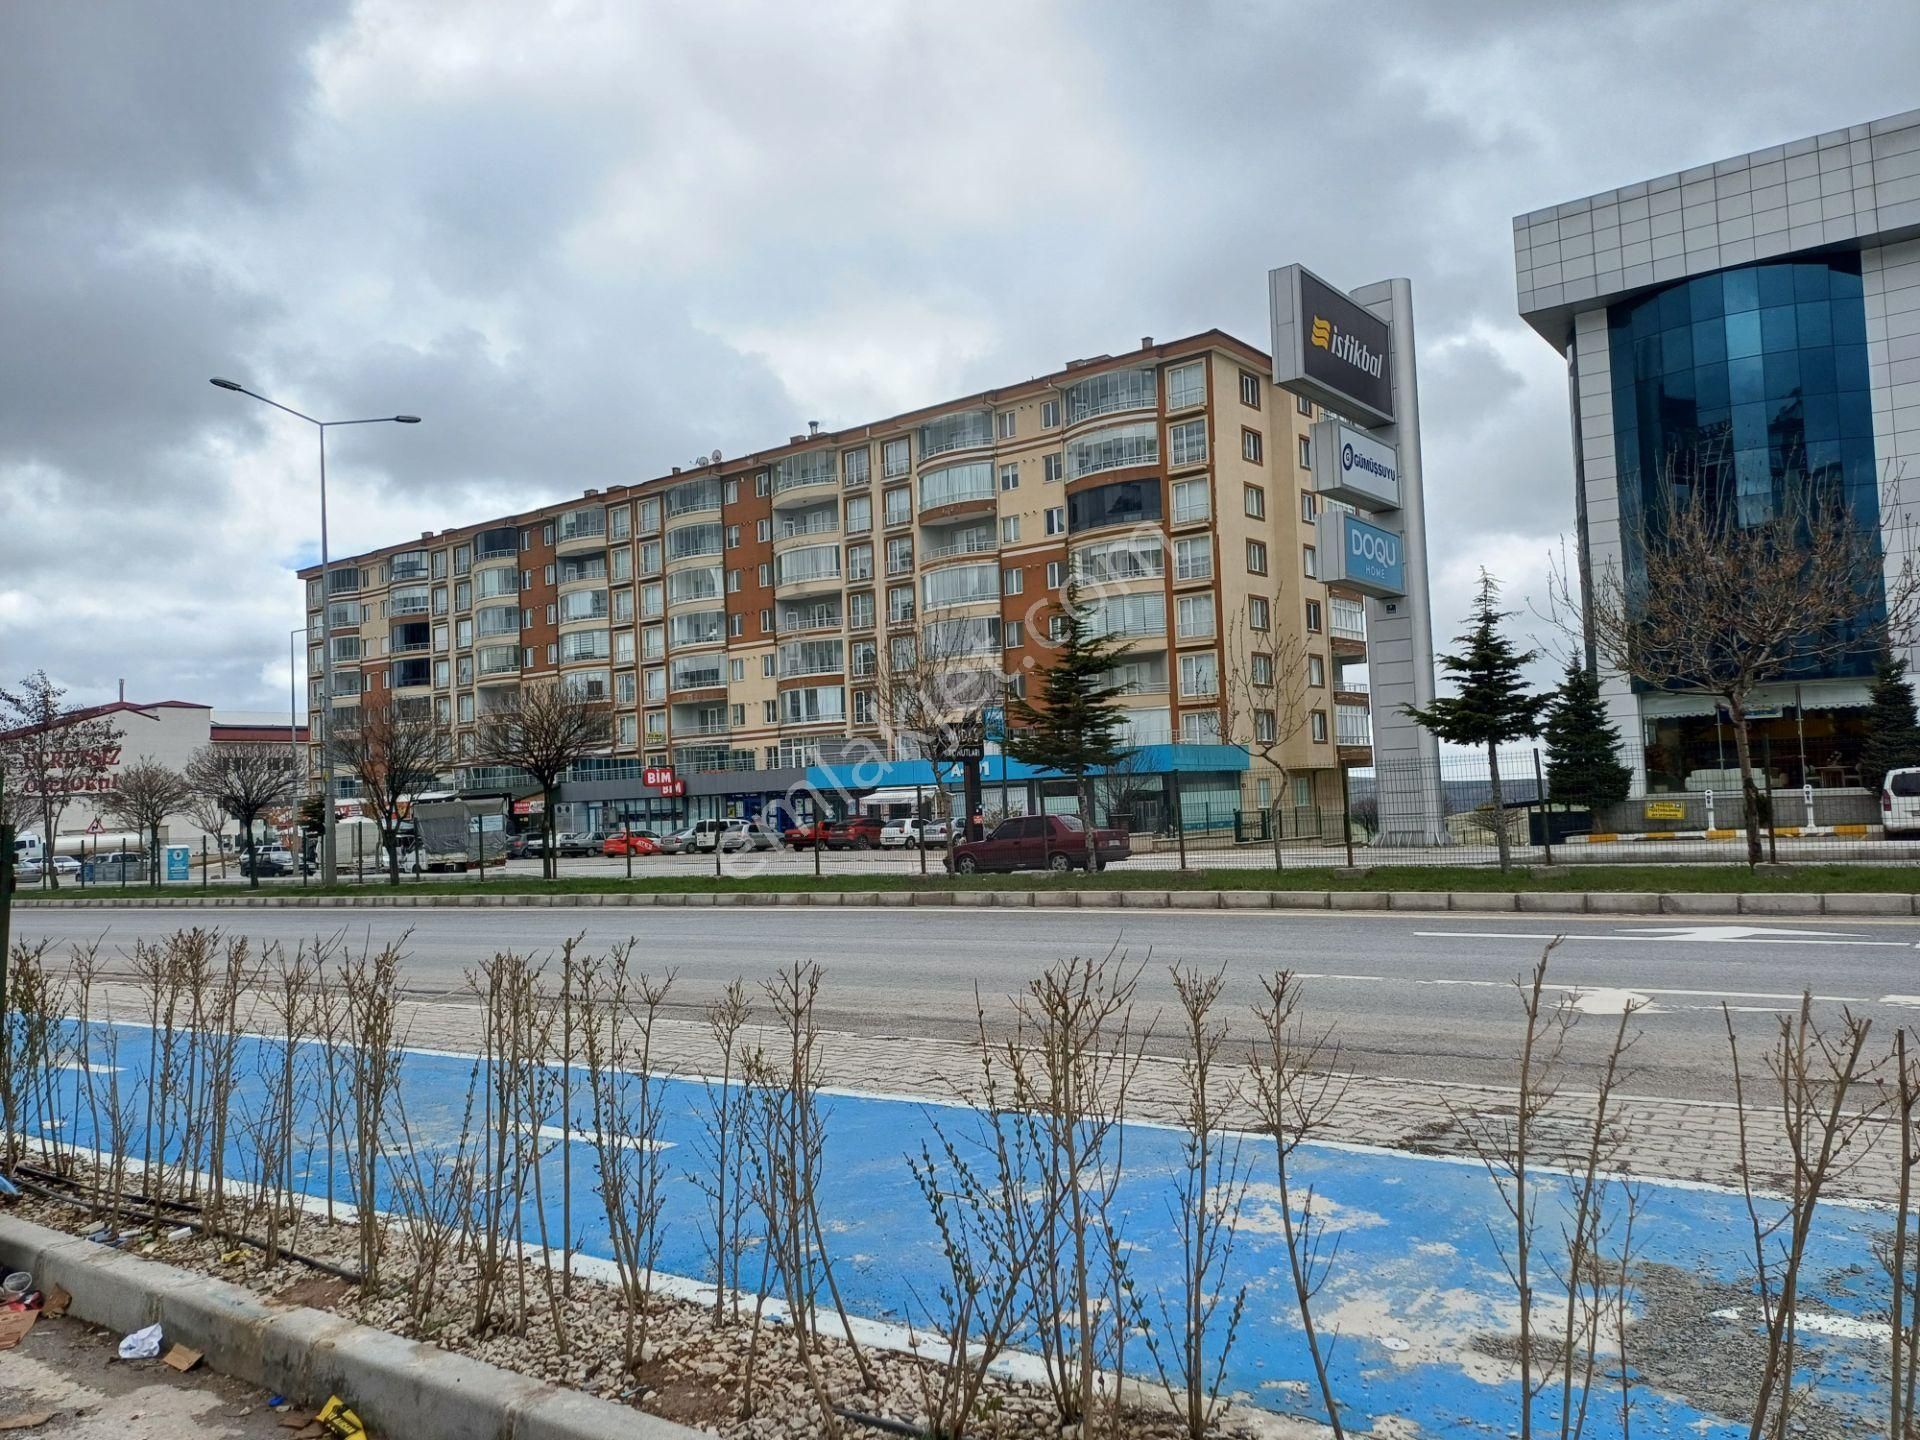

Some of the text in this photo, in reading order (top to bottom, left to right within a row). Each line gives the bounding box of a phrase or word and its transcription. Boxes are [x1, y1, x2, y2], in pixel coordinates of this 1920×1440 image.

[1331, 325, 1383, 379] istikbal
[1354, 453, 1396, 482] GÜMÜŞSUYU
[1351, 528, 1396, 569] DOQU
[1365, 564, 1385, 579] HOME
[647, 769, 672, 784] BİM
